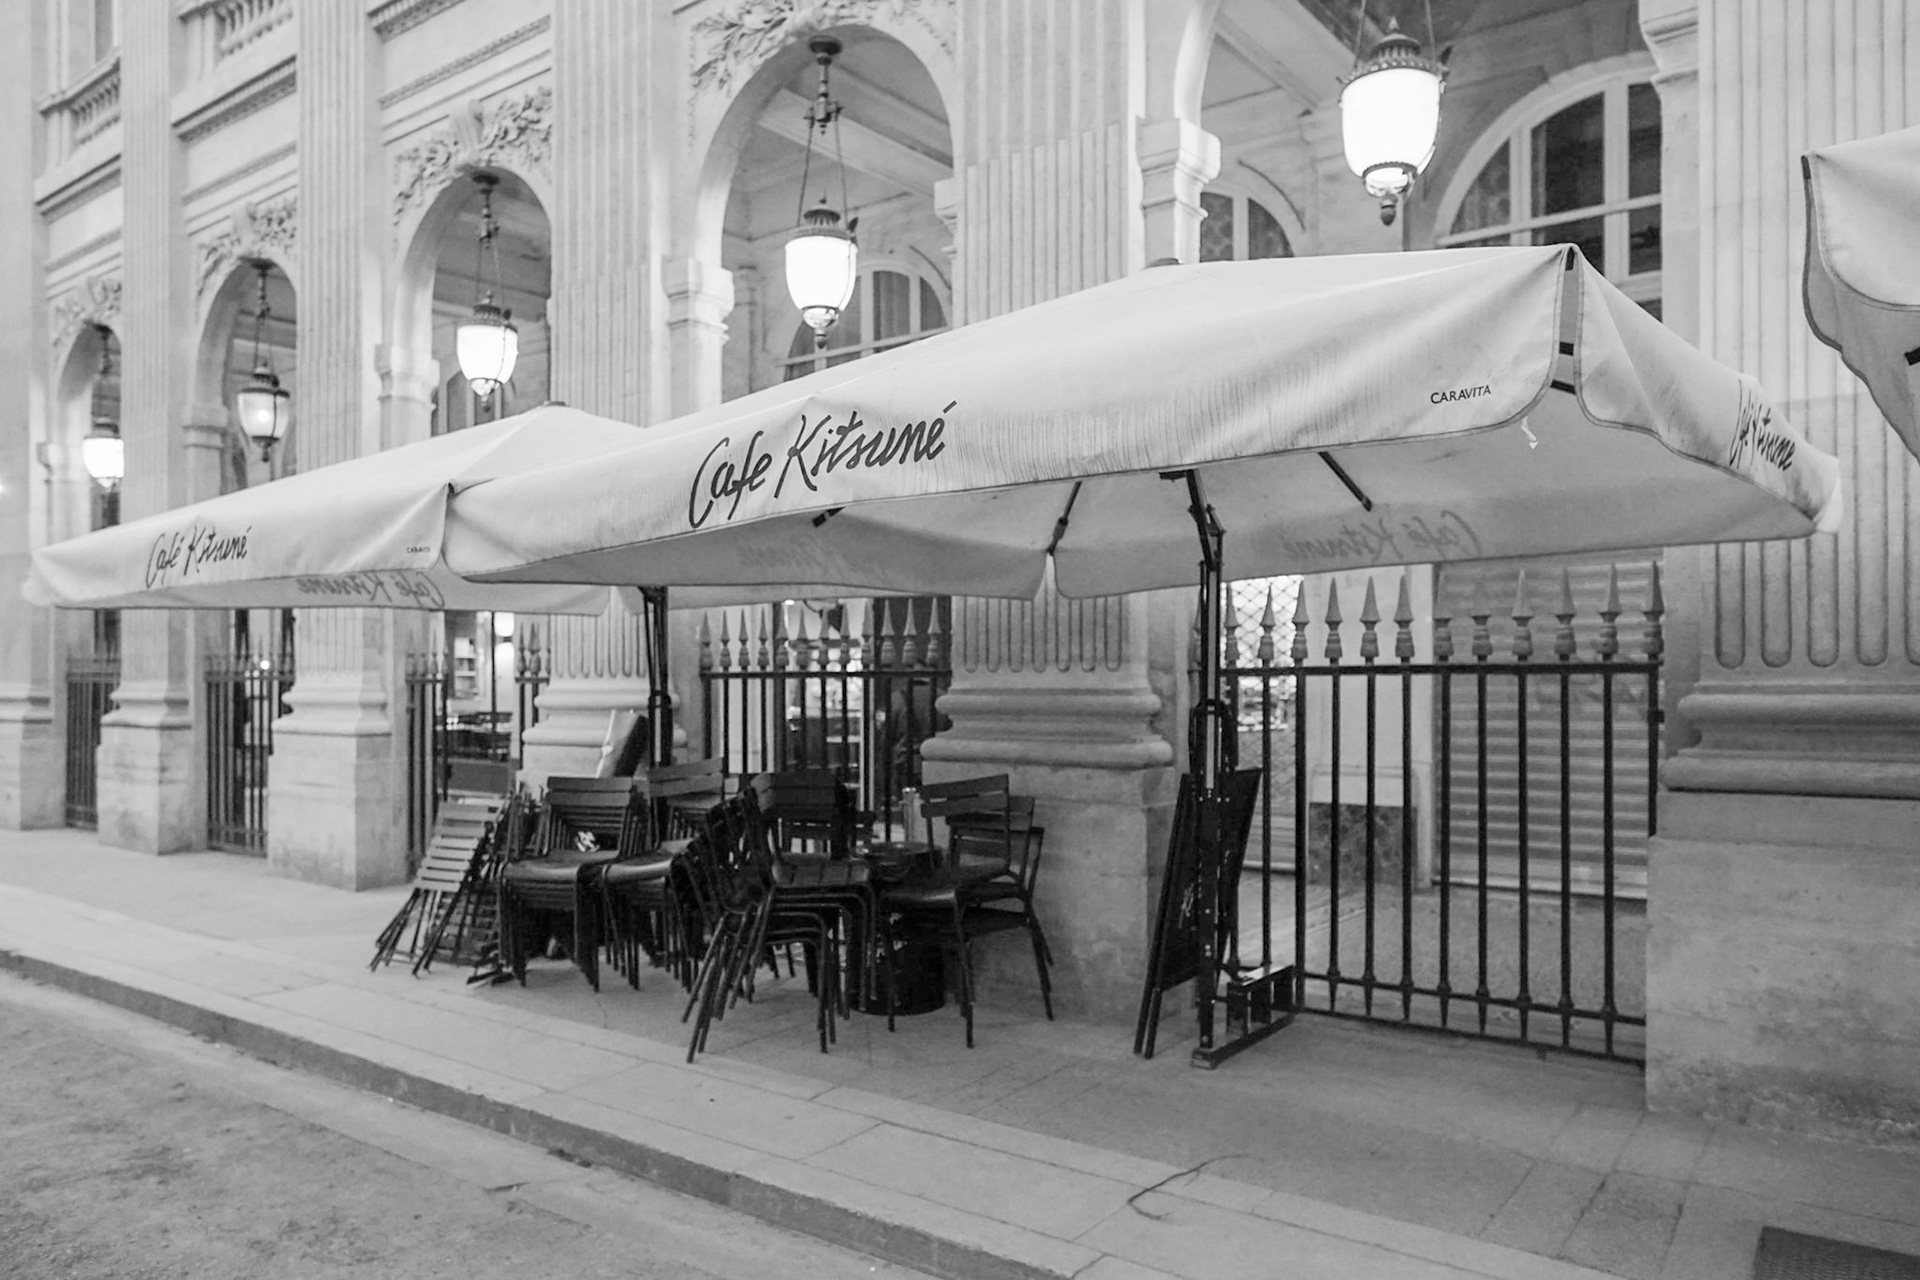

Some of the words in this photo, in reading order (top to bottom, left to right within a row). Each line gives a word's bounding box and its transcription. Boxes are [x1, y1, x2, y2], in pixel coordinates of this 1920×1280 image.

[1430, 384, 1492, 404] CARAVITA
[773, 400, 957, 499] Kitsuné
[146, 532, 185, 589] Café
